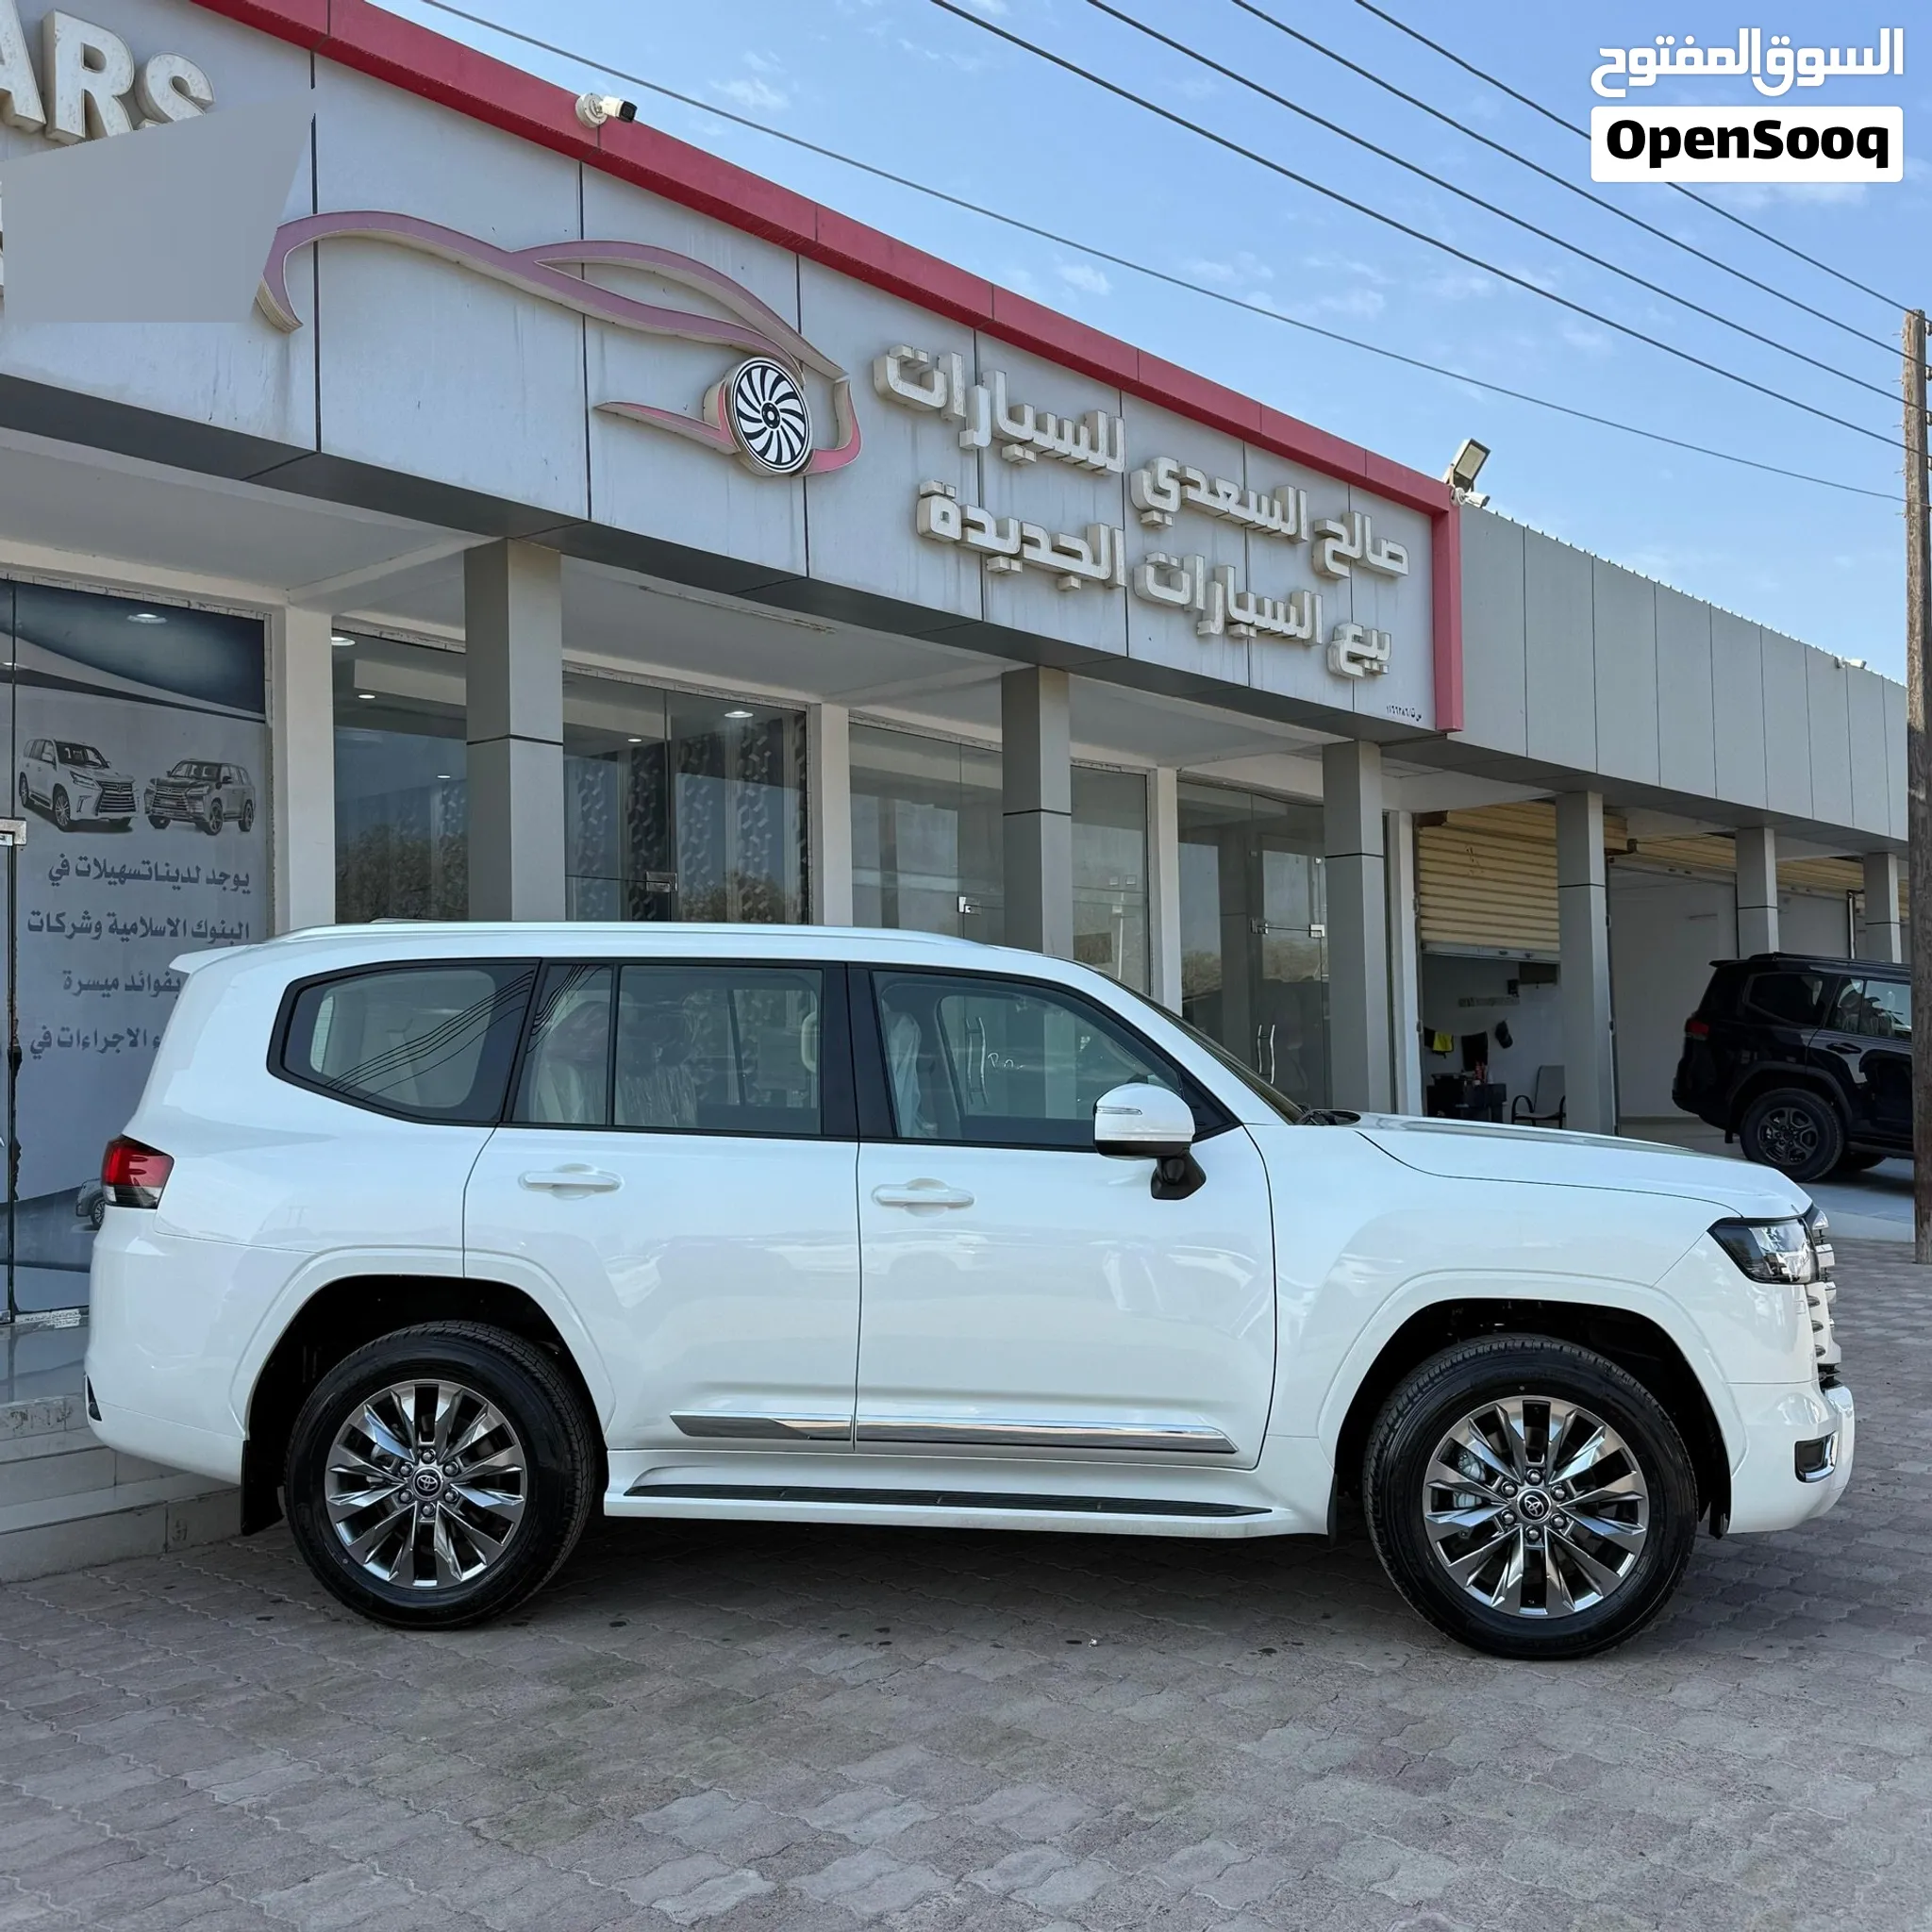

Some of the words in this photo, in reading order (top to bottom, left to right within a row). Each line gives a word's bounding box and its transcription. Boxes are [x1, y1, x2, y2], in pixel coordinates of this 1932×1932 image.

[874, 343, 1127, 476] للسيارات
[1131, 456, 1309, 542] السعدي
[916, 479, 1127, 592] الجديدة
[1312, 510, 1409, 580] صالح
[1134, 551, 1324, 647] السيارات
[1327, 623, 1392, 679] بيع
[48, 853, 71, 887] في
[206, 868, 251, 895] يوجد
[27, 910, 103, 940] وشركات
[107, 911, 188, 942] الاسلامية
[191, 918, 250, 946] البنوك
[62, 970, 120, 998] ميسرة
[29, 1024, 53, 1059] في
